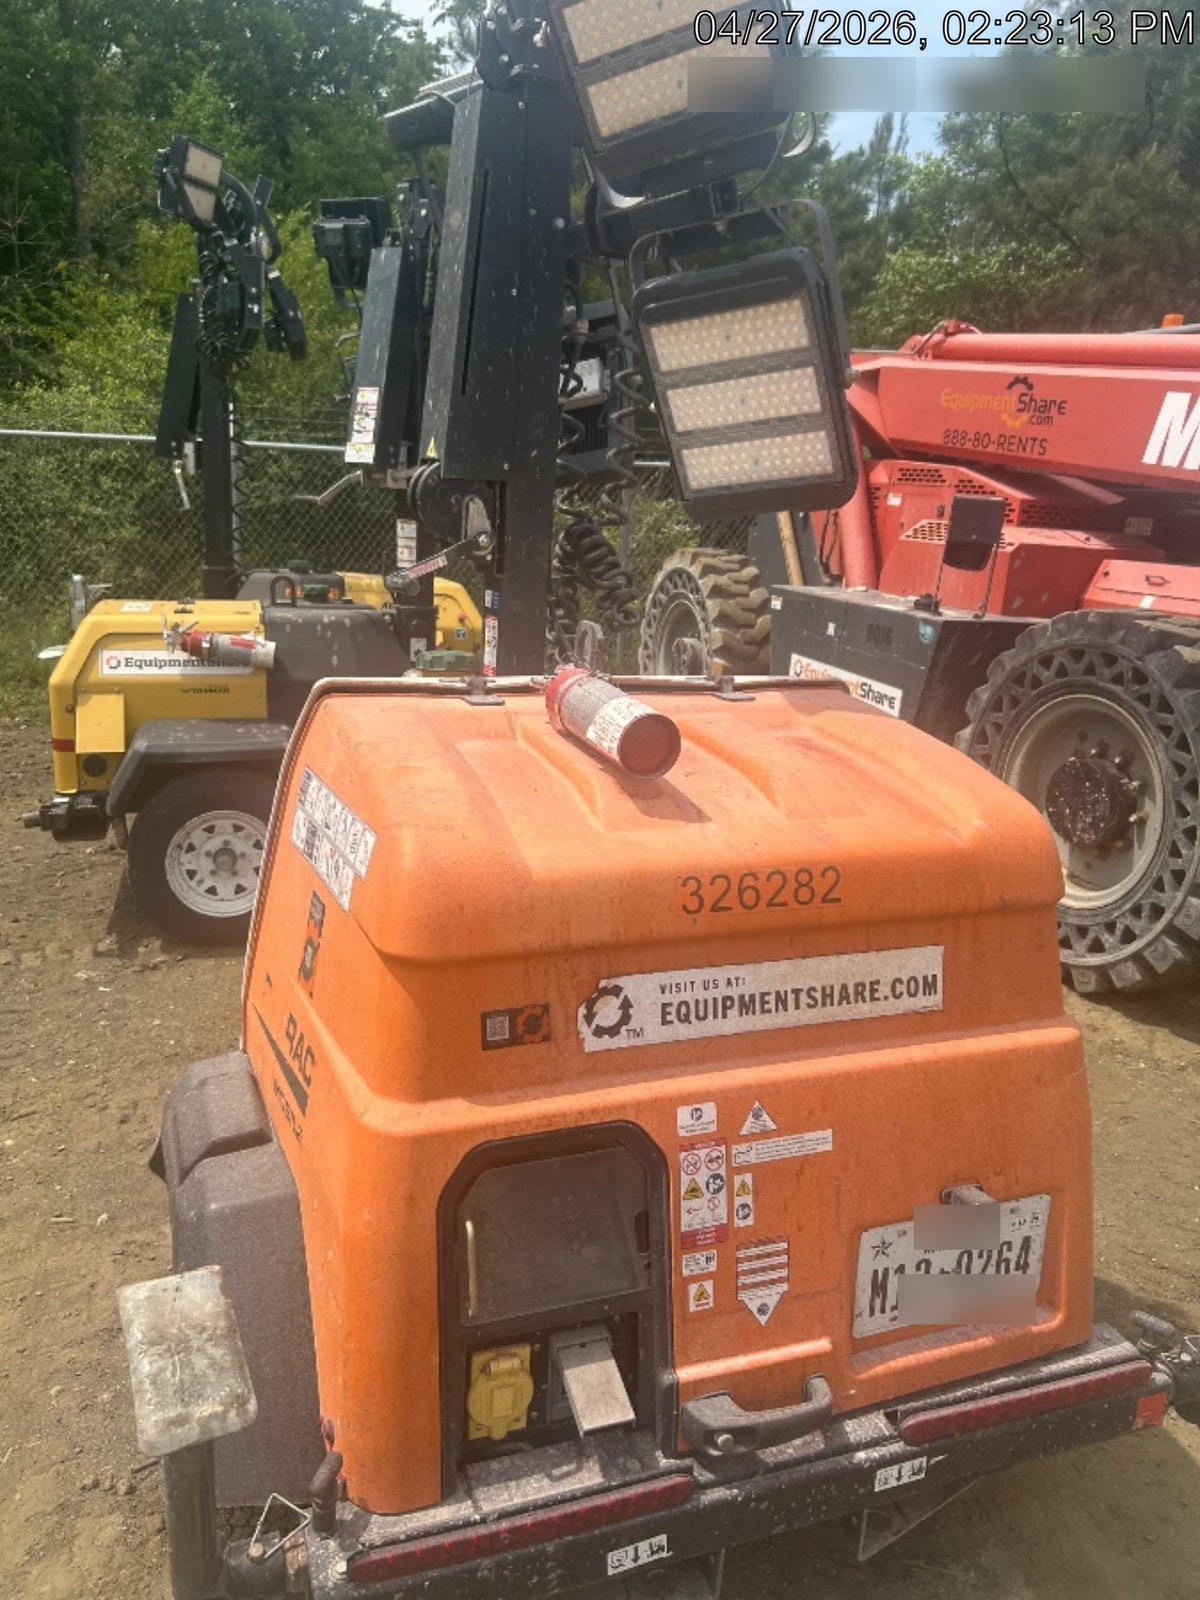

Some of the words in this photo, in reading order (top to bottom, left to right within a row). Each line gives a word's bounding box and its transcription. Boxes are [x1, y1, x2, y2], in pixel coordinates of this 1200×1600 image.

[941, 388, 1068, 416] EquipmentShare
[943, 427, 1049, 456] 888-80-RENTS
[680, 865, 843, 916] 326282
[659, 980, 697, 996] VISIT
[702, 977, 721, 991] US
[725, 975, 748, 989] AT:
[660, 973, 939, 1027] EQUIPMENTSHARE.COM
[625, 1026, 646, 1040] TM
